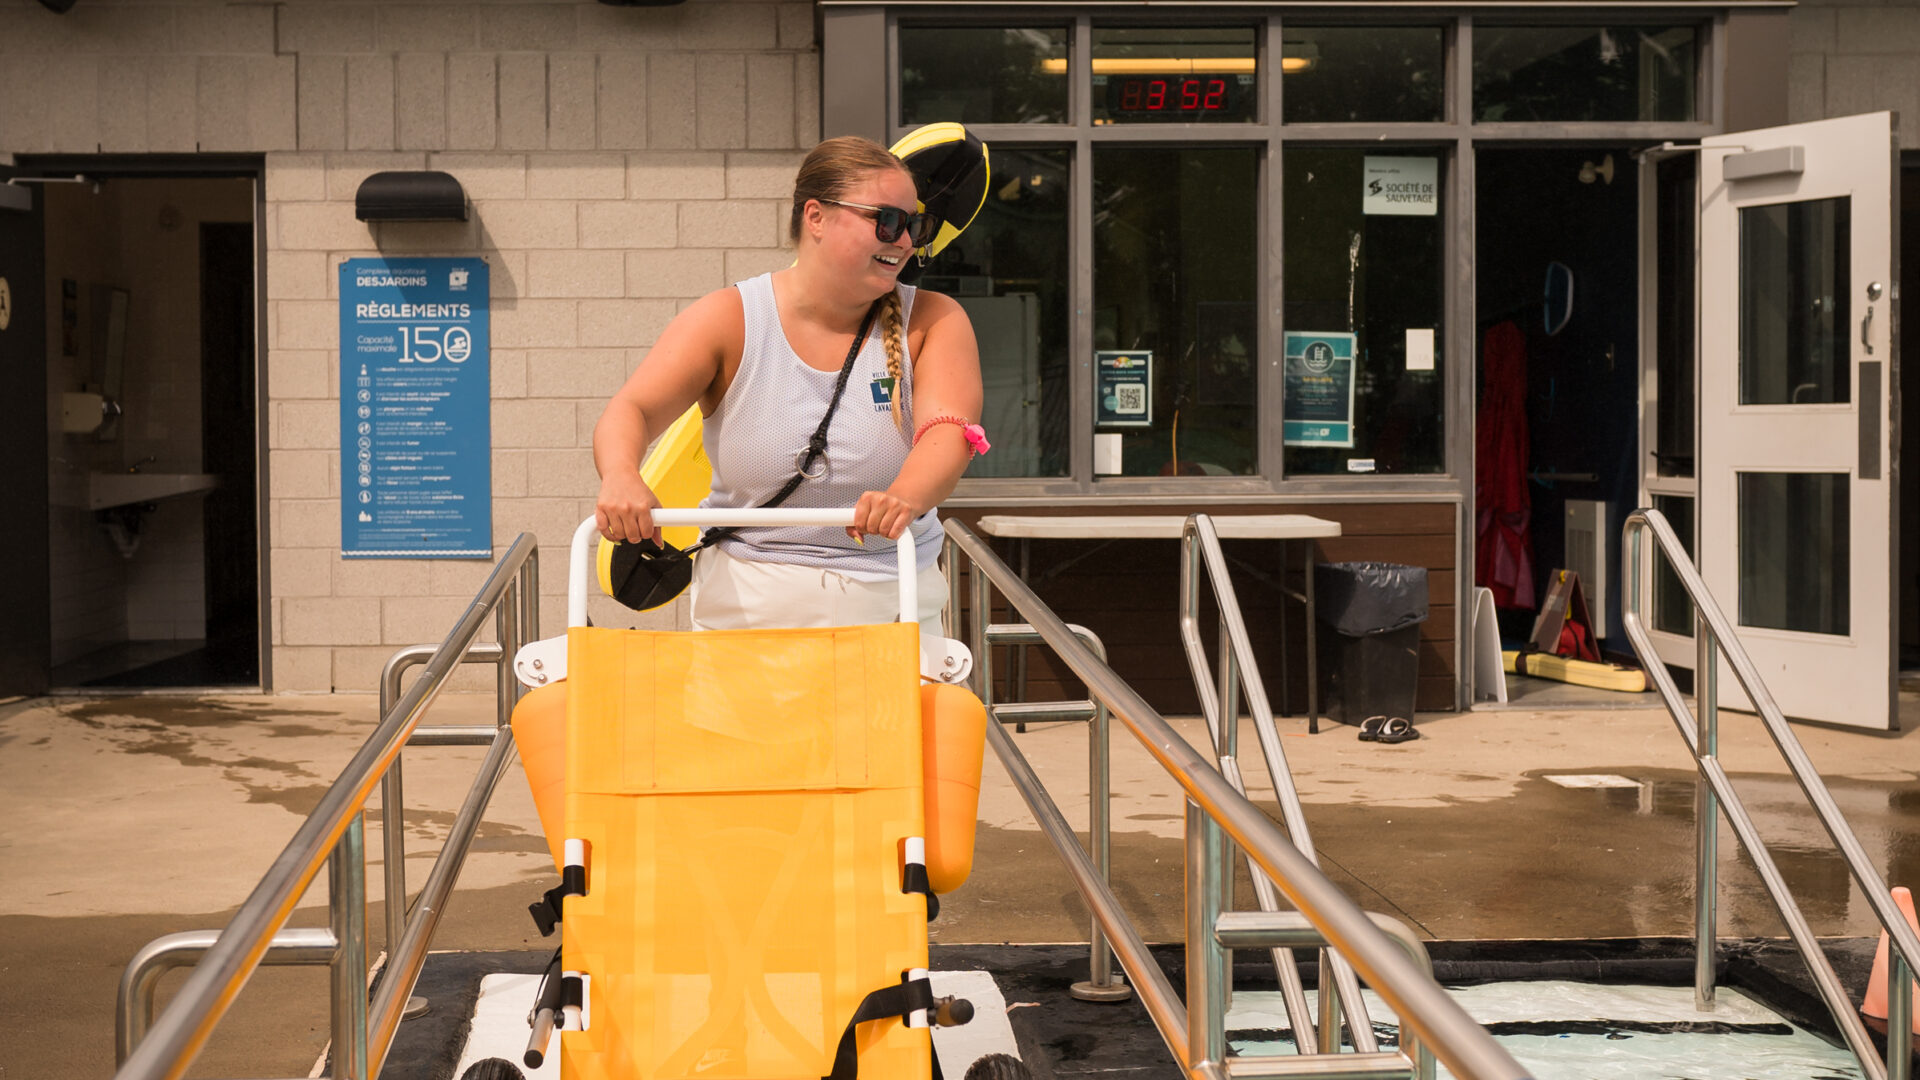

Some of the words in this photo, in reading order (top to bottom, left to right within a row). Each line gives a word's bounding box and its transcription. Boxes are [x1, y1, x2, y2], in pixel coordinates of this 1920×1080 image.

[1385, 182, 1420, 193] SOCIÉTÉ
[1422, 183, 1434, 193] DE
[1385, 194, 1433, 203] SAUVETAGE
[356, 276, 427, 287] DESJARDINS
[356, 300, 471, 318] RÈGLEMENTS
[356, 335, 394, 346] Capacité
[398, 326, 471, 363] 150
[357, 344, 397, 353] maximale
